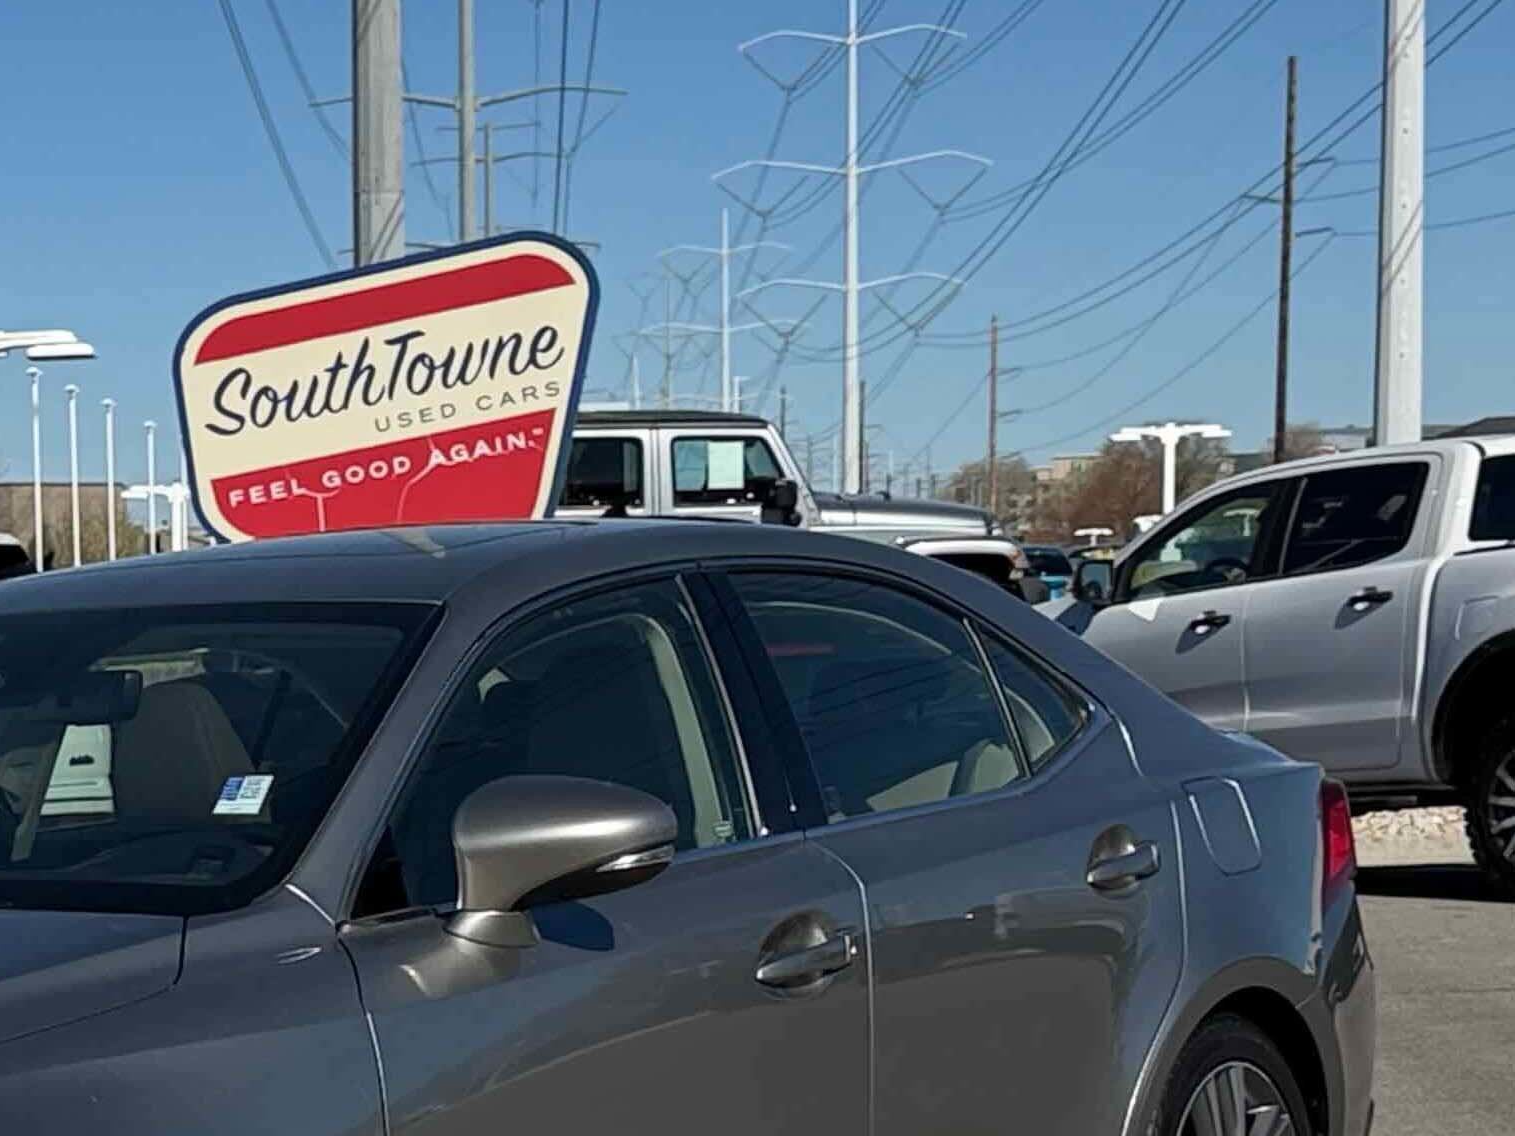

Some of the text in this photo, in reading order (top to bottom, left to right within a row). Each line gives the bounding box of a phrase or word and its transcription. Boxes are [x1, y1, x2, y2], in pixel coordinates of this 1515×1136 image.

[205, 325, 566, 436] SouthTowne
[374, 380, 562, 433] USED CARS
[228, 476, 307, 508] FEEL
[321, 455, 413, 490] GOOD
